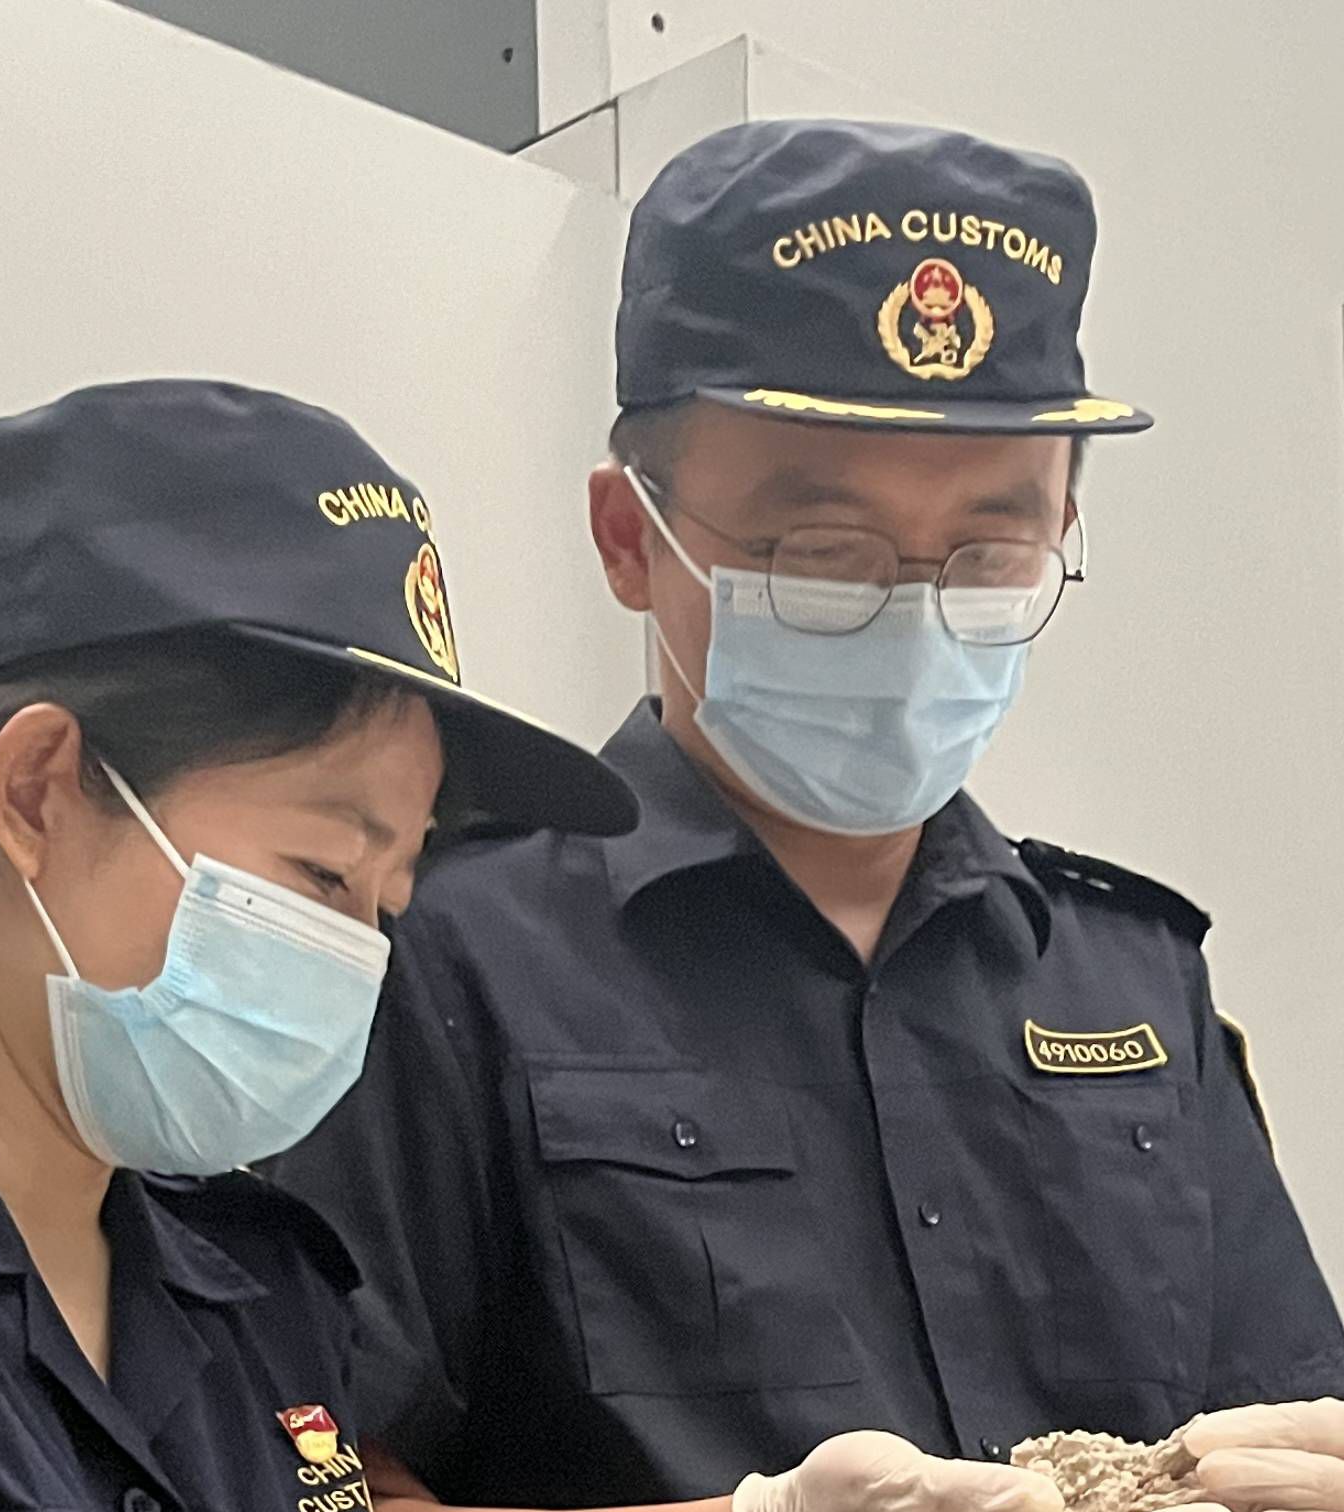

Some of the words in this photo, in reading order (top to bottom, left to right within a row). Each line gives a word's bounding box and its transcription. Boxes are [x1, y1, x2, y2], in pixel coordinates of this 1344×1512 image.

[772, 212, 893, 268] CHINA
[900, 208, 1064, 285] CUSTOMS
[317, 482, 412, 527] CHINA
[1038, 1040, 1145, 1063] 4910060
